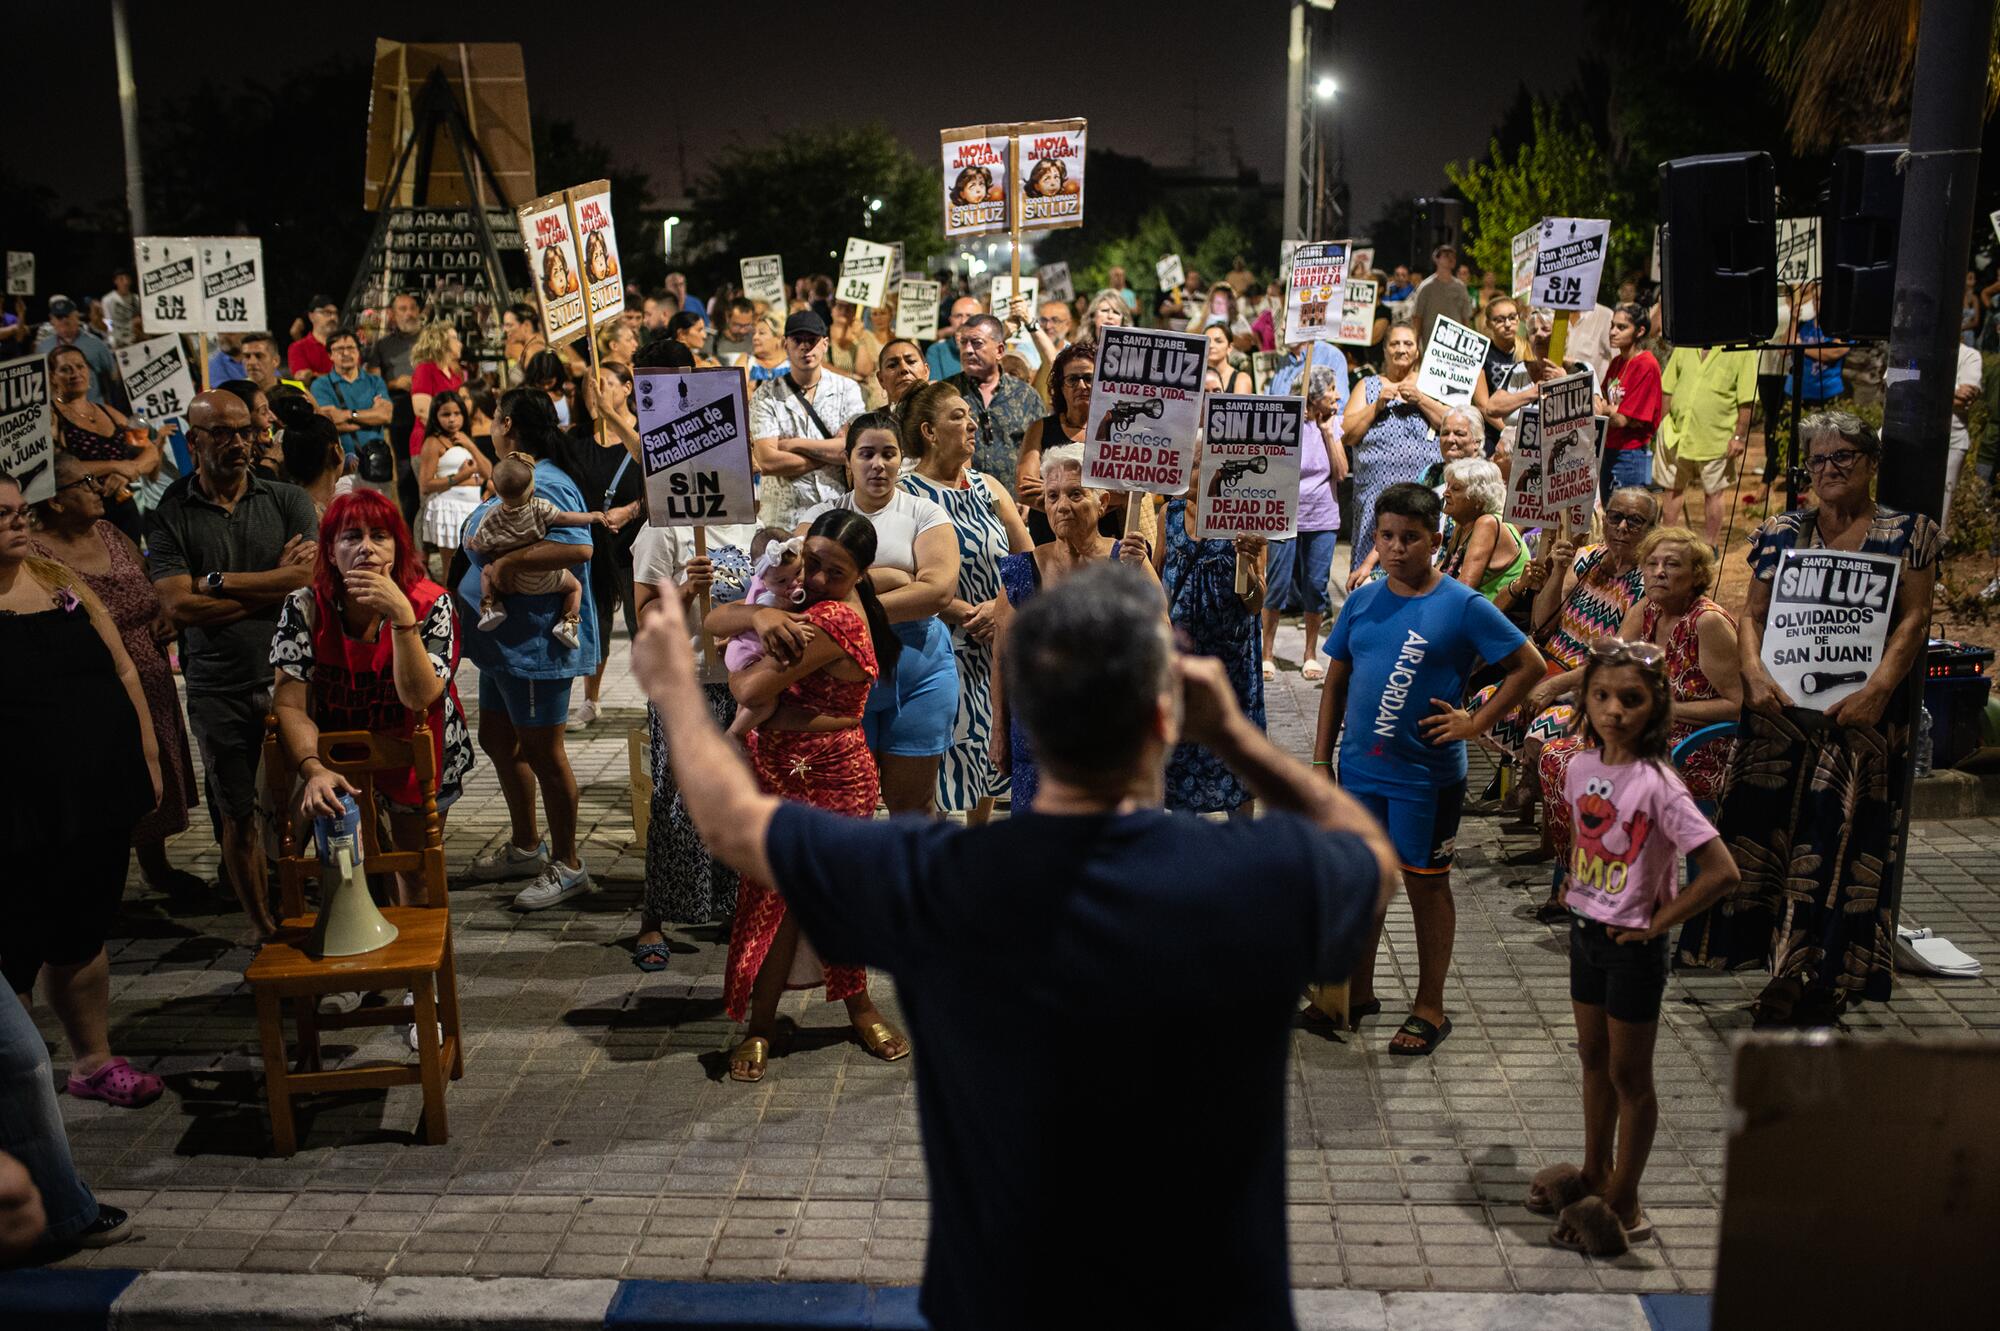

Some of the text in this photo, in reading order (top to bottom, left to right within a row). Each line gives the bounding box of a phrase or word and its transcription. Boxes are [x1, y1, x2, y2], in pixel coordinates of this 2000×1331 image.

[959, 143, 992, 159] MOYA
[1035, 136, 1068, 150] MOYA
[953, 152, 1002, 168] DA LA CARA!
[1028, 146, 1077, 160] DA LA CARA!
[977, 208, 1003, 222] LUZ
[1051, 201, 1076, 214] LUZ
[1540, 251, 1557, 262] San
[1559, 244, 1580, 257] Juan
[1540, 250, 1599, 274] Aznalfarache
[1295, 267, 1328, 276] CUANDO
[1294, 275, 1341, 288] EMPIEZA
[845, 289, 869, 300] LUZ
[1544, 290, 1581, 304] LUZ
[155, 308, 187, 320] LUZ
[216, 310, 248, 321] LUZ
[1123, 335, 1152, 347] SANTA
[1154, 339, 1187, 351] ISABEL
[1436, 325, 1461, 349] SIN
[1458, 335, 1485, 361] LUZ
[1104, 345, 1200, 386] SIN LUZ
[1432, 349, 1476, 367] OLVIDADOS
[1430, 367, 1446, 378] SAN
[10, 373, 43, 407] LUZ
[1102, 382, 1193, 401] LA LUZ ES VIDA...
[147, 400, 182, 419] LUZ
[1226, 402, 1253, 411] SANTA
[1255, 403, 1285, 412] ISABEL
[1543, 387, 1590, 424] SIN LUZ
[643, 406, 723, 452] San Juan de
[1211, 411, 1297, 441] SIN LUZ
[1546, 428, 1553, 436] LA
[649, 422, 736, 471] Aznalfarache
[1113, 432, 1172, 448] endesa
[15, 437, 47, 465] JUAN!
[1100, 443, 1180, 466] DEJAD DE
[1211, 445, 1294, 456] LA LUZ ES VIDA...
[1521, 449, 1531, 457] LA
[1091, 461, 1183, 485] MATARNOS!
[1551, 466, 1590, 490] DEJAD DE
[1223, 487, 1276, 499] endesa
[1518, 494, 1543, 506] DEJ
[1547, 480, 1593, 505] MATARNOS!
[667, 495, 727, 519] LUZ
[1212, 499, 1285, 515] DEJAD DE
[1206, 515, 1289, 531] MATARNOS!
[1802, 558, 1873, 572] SANTA ISABEL
[1781, 567, 1887, 606] SIN LUZ
[1775, 608, 1874, 629] OLVIDADOS
[1786, 625, 1860, 638] EN UN RINCÓN
[1814, 636, 1829, 645] DE
[1774, 646, 1872, 666] SAN JUAN!
[1373, 629, 1430, 737] AIR JORDAN
